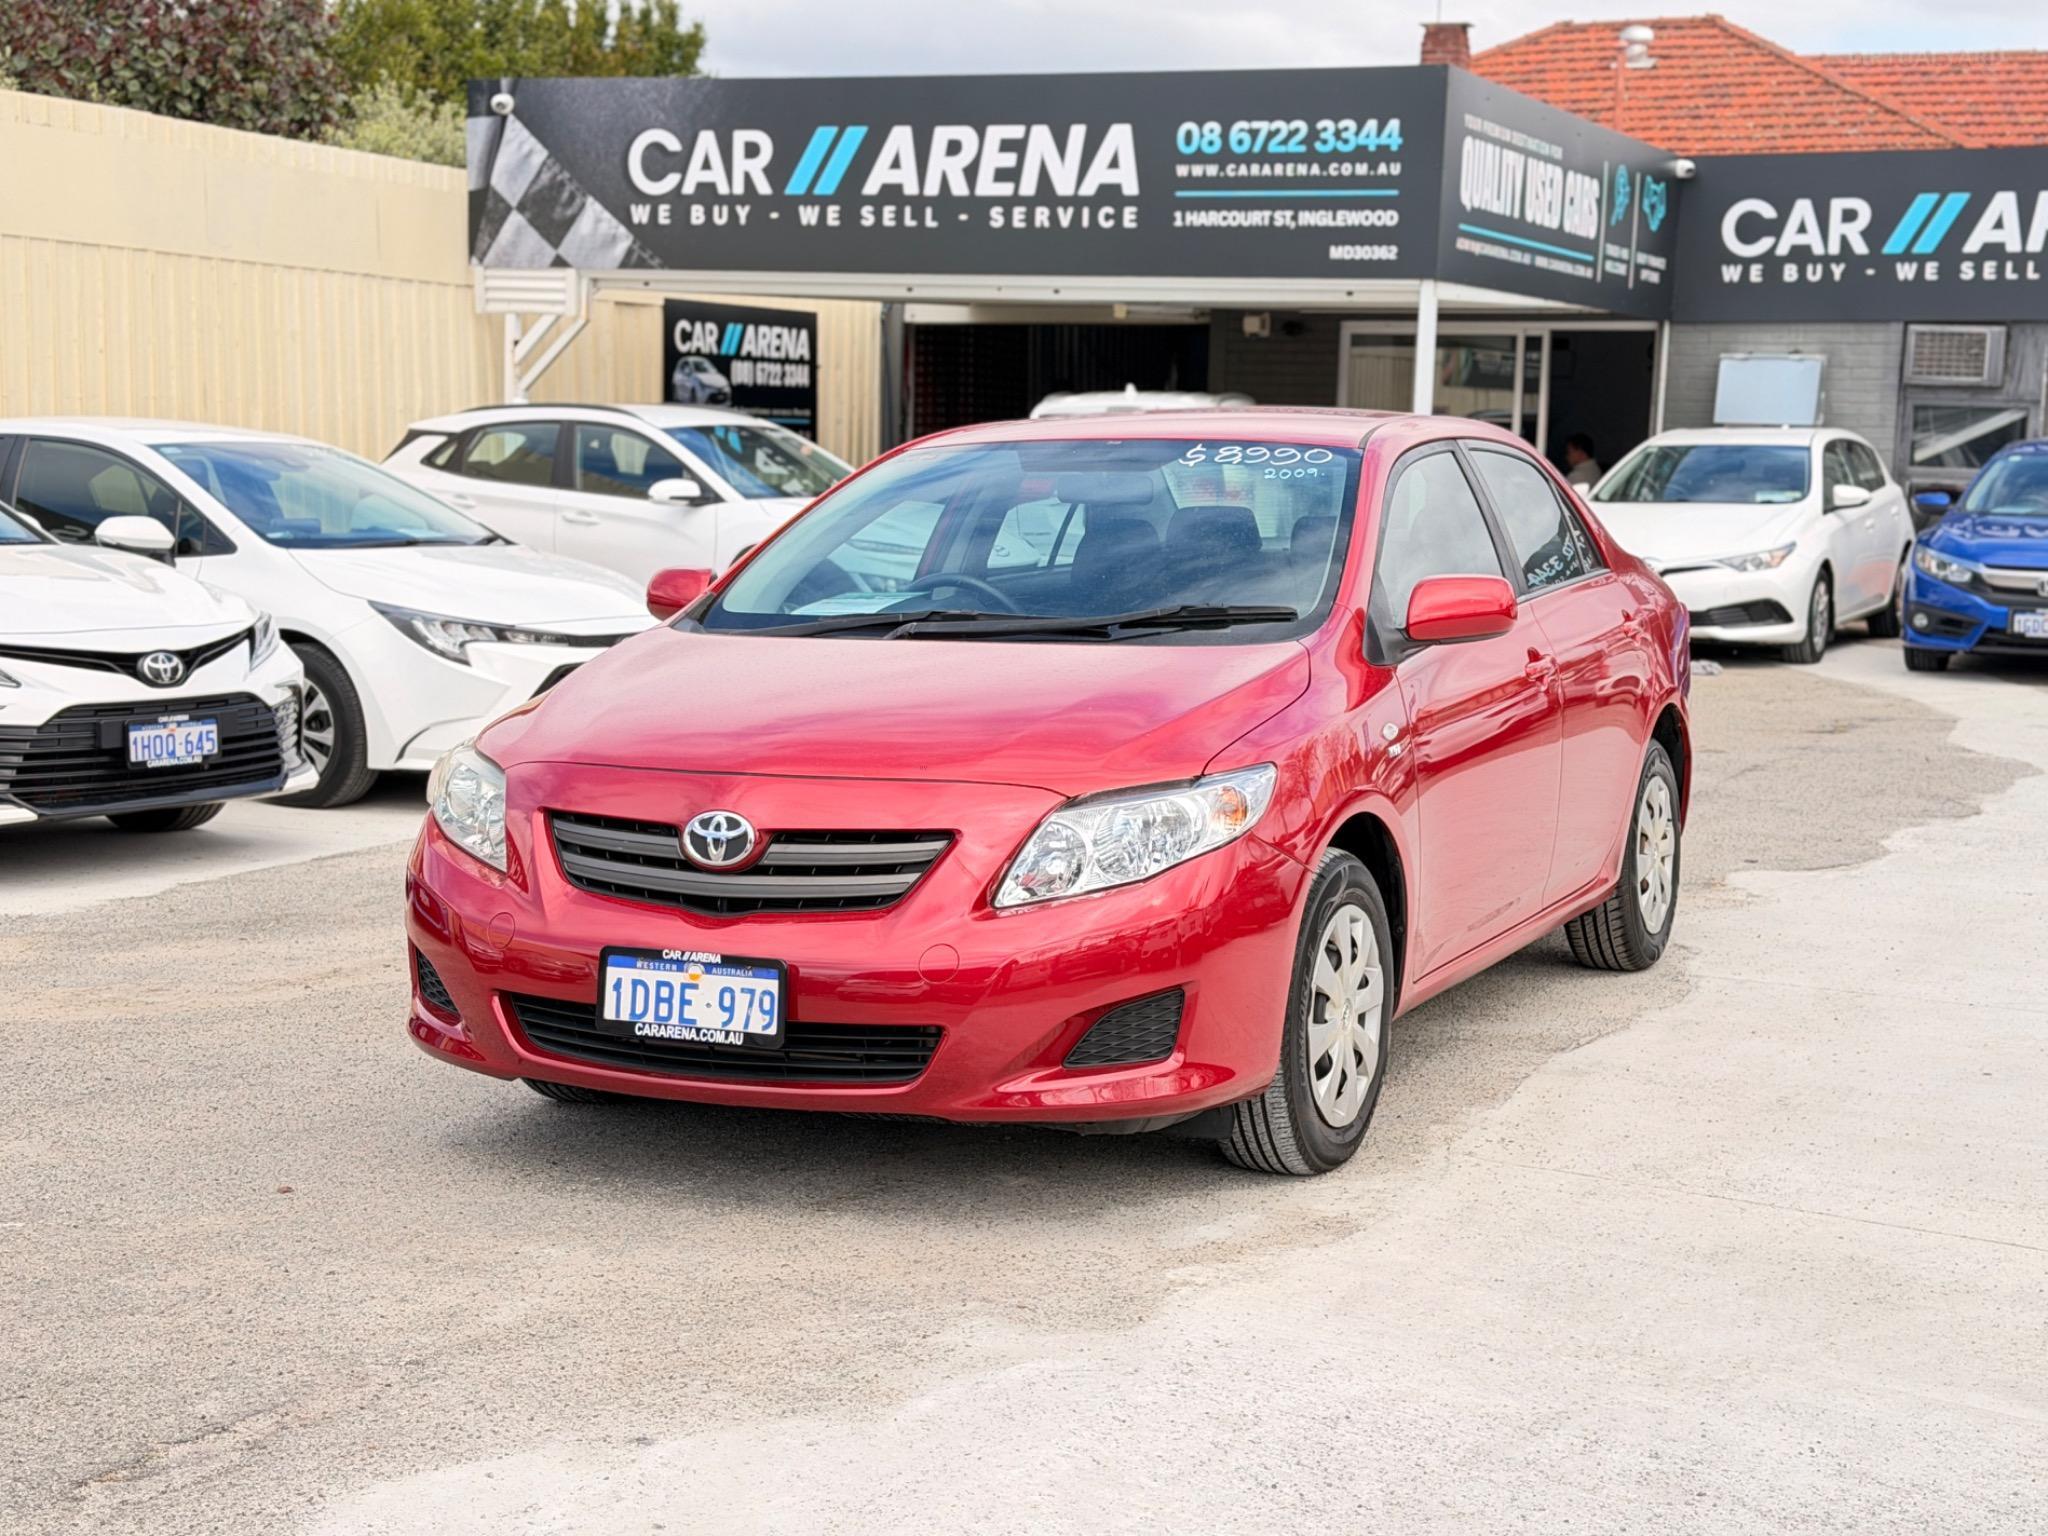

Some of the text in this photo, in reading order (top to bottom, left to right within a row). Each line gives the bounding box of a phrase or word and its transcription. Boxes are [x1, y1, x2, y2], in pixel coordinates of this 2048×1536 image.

[1176, 117, 1404, 155] 08 6722 3344
[627, 122, 1140, 197] CAR ARENA
[1175, 161, 1402, 178] WWW.CARARENA.COM.AU
[1460, 135, 1525, 219] QUALITY
[1525, 156, 1563, 230] USED
[1563, 169, 1600, 240] CARS
[629, 203, 671, 225] WE
[690, 203, 751, 226] BUY
[798, 204, 841, 226] WE
[860, 204, 939, 227] SELL
[989, 205, 1139, 229] SERVICE
[1173, 209, 1399, 229] 1 HARCOURT ST, INGLEWOOD
[1721, 197, 1872, 258] CAR
[1328, 244, 1398, 261] MD30362
[1721, 263, 1763, 283] WE
[1783, 262, 1846, 283] BUY
[1895, 261, 1940, 281] WE
[1959, 260, 2040, 281] SELL
[674, 319, 810, 361] CAR ARENA
[662, 949, 721, 964] CAR ARENA
[636, 960, 753, 977] WESTERN AUSTRALIA
[634, 1023, 744, 1045] CARARENA.COM.AU
